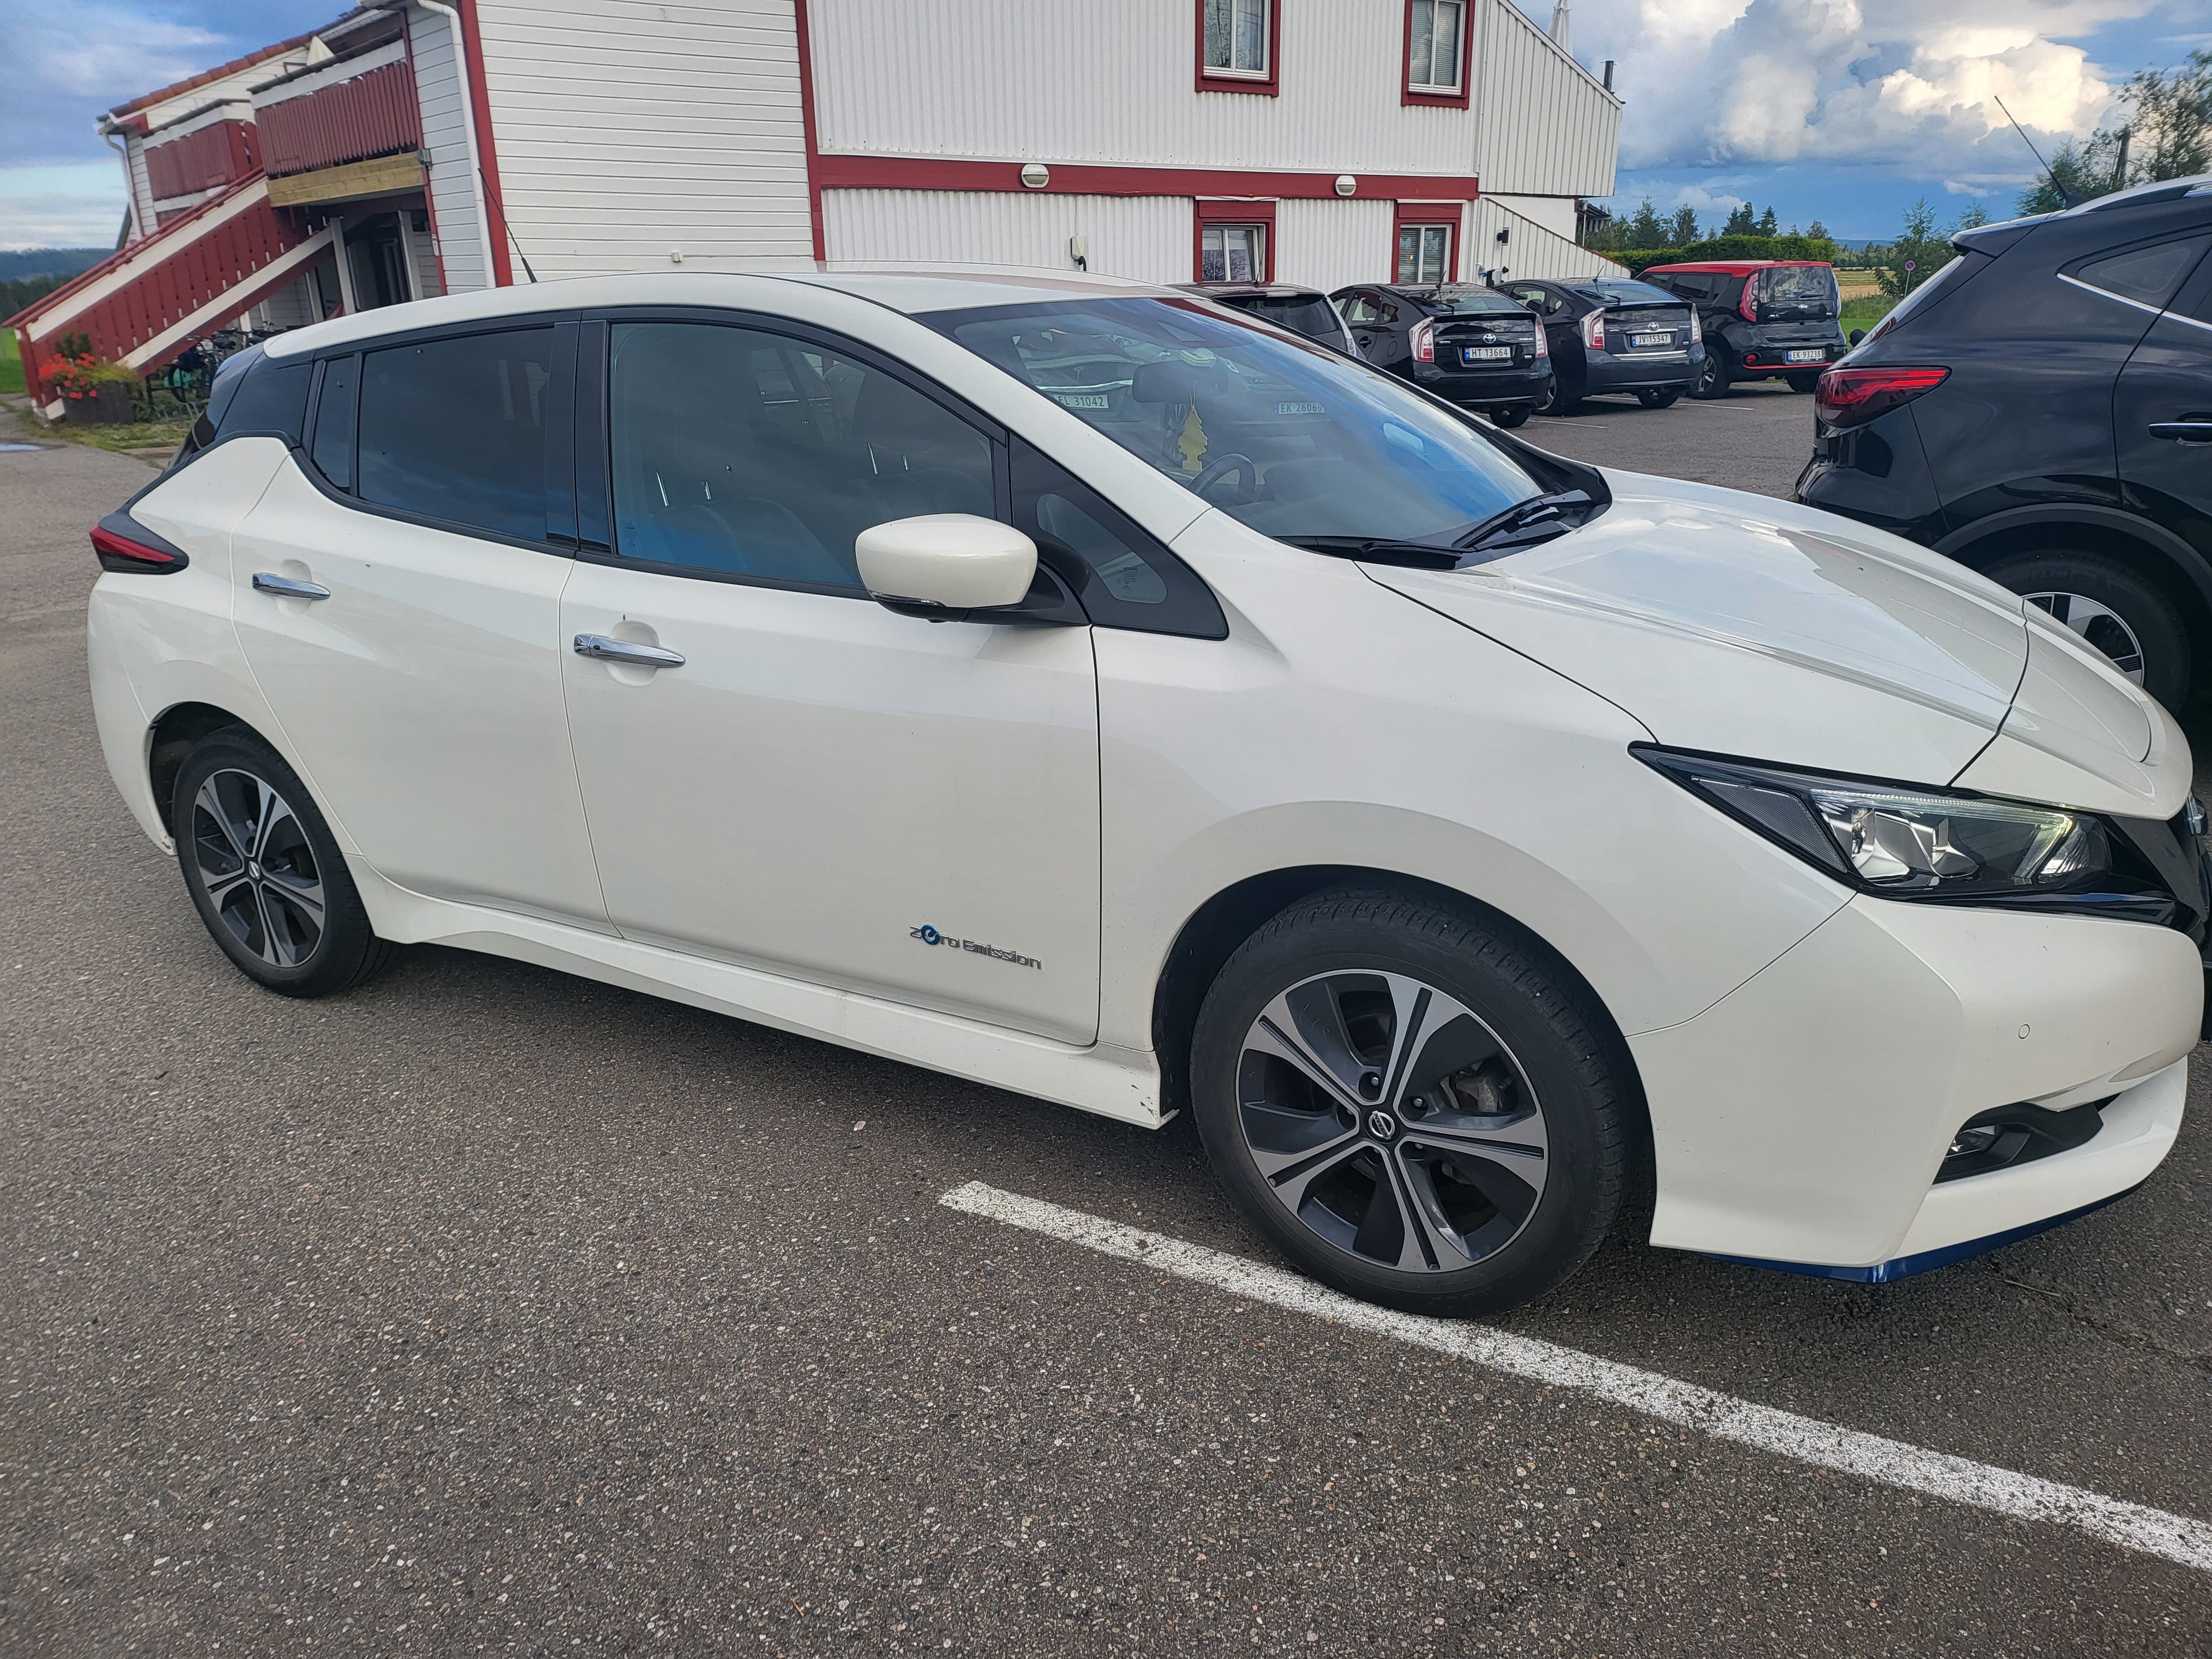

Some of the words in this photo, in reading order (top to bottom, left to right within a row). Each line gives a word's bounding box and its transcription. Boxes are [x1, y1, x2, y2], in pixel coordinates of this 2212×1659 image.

[1648, 335, 1668, 343] 15347
[1485, 348, 1508, 357] 13664
[1058, 396, 1071, 405] EL
[1073, 397, 1104, 406] 31042
[1281, 404, 1292, 413] EK
[1296, 403, 1323, 412] 26069
[963, 938, 1042, 970] Emission
[1374, 1114, 1389, 1138] NISSAN
